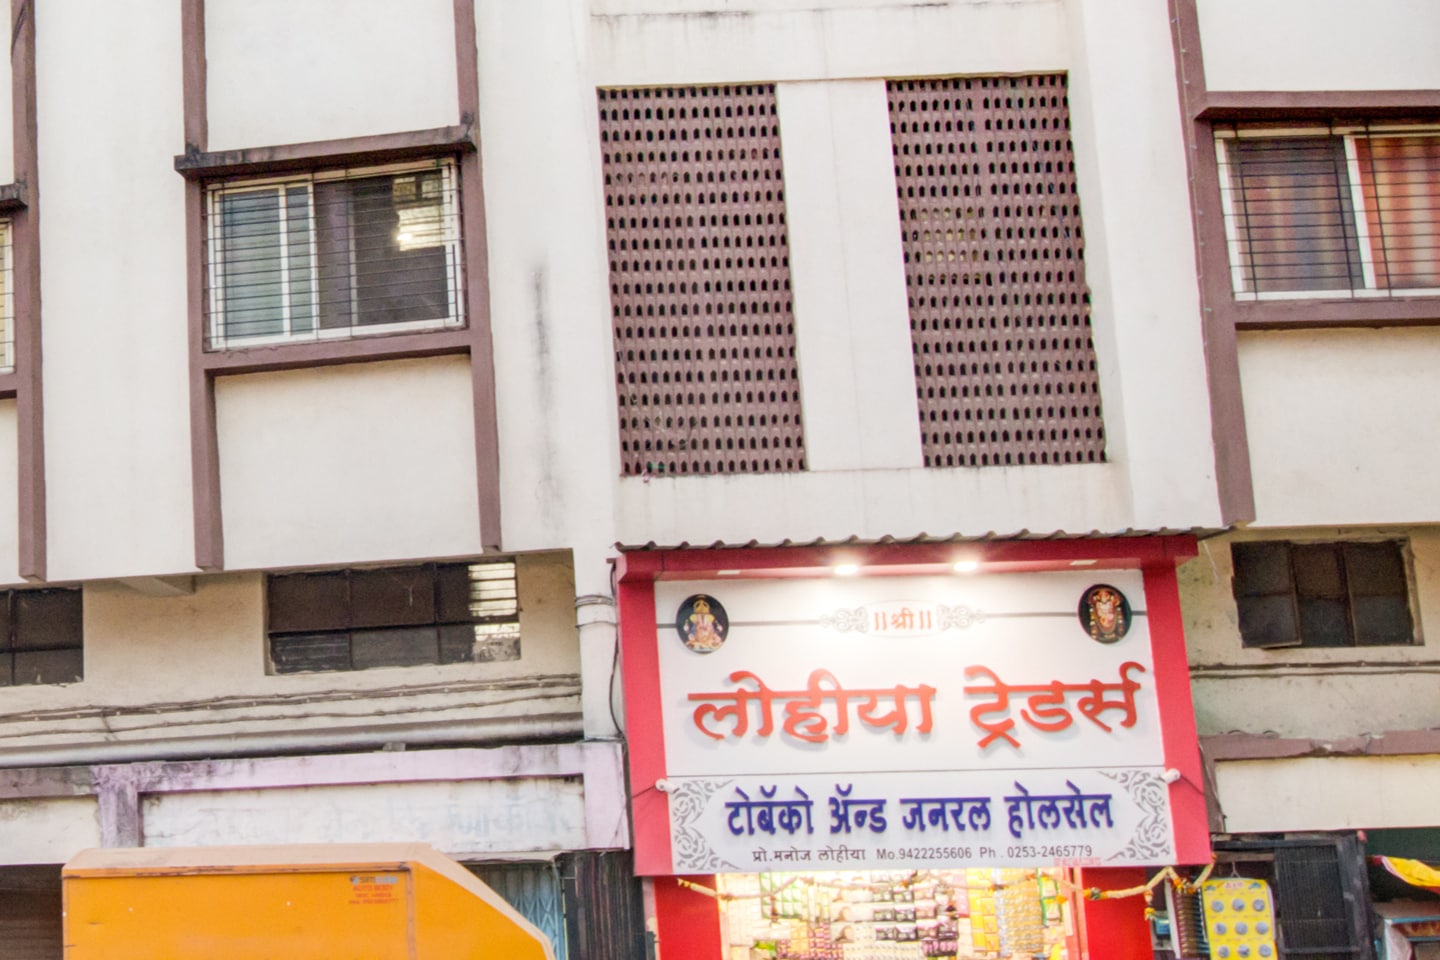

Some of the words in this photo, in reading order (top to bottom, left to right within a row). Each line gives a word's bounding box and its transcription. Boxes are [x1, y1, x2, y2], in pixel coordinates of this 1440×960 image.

[687, 668, 937, 741] लोहीया
[963, 661, 1146, 749] ट्रेडर्स
[724, 786, 815, 837] टोबॅको
[900, 796, 992, 833] जनरल
[1003, 780, 1115, 839] होलसेल
[817, 845, 866, 863] लोहीया
